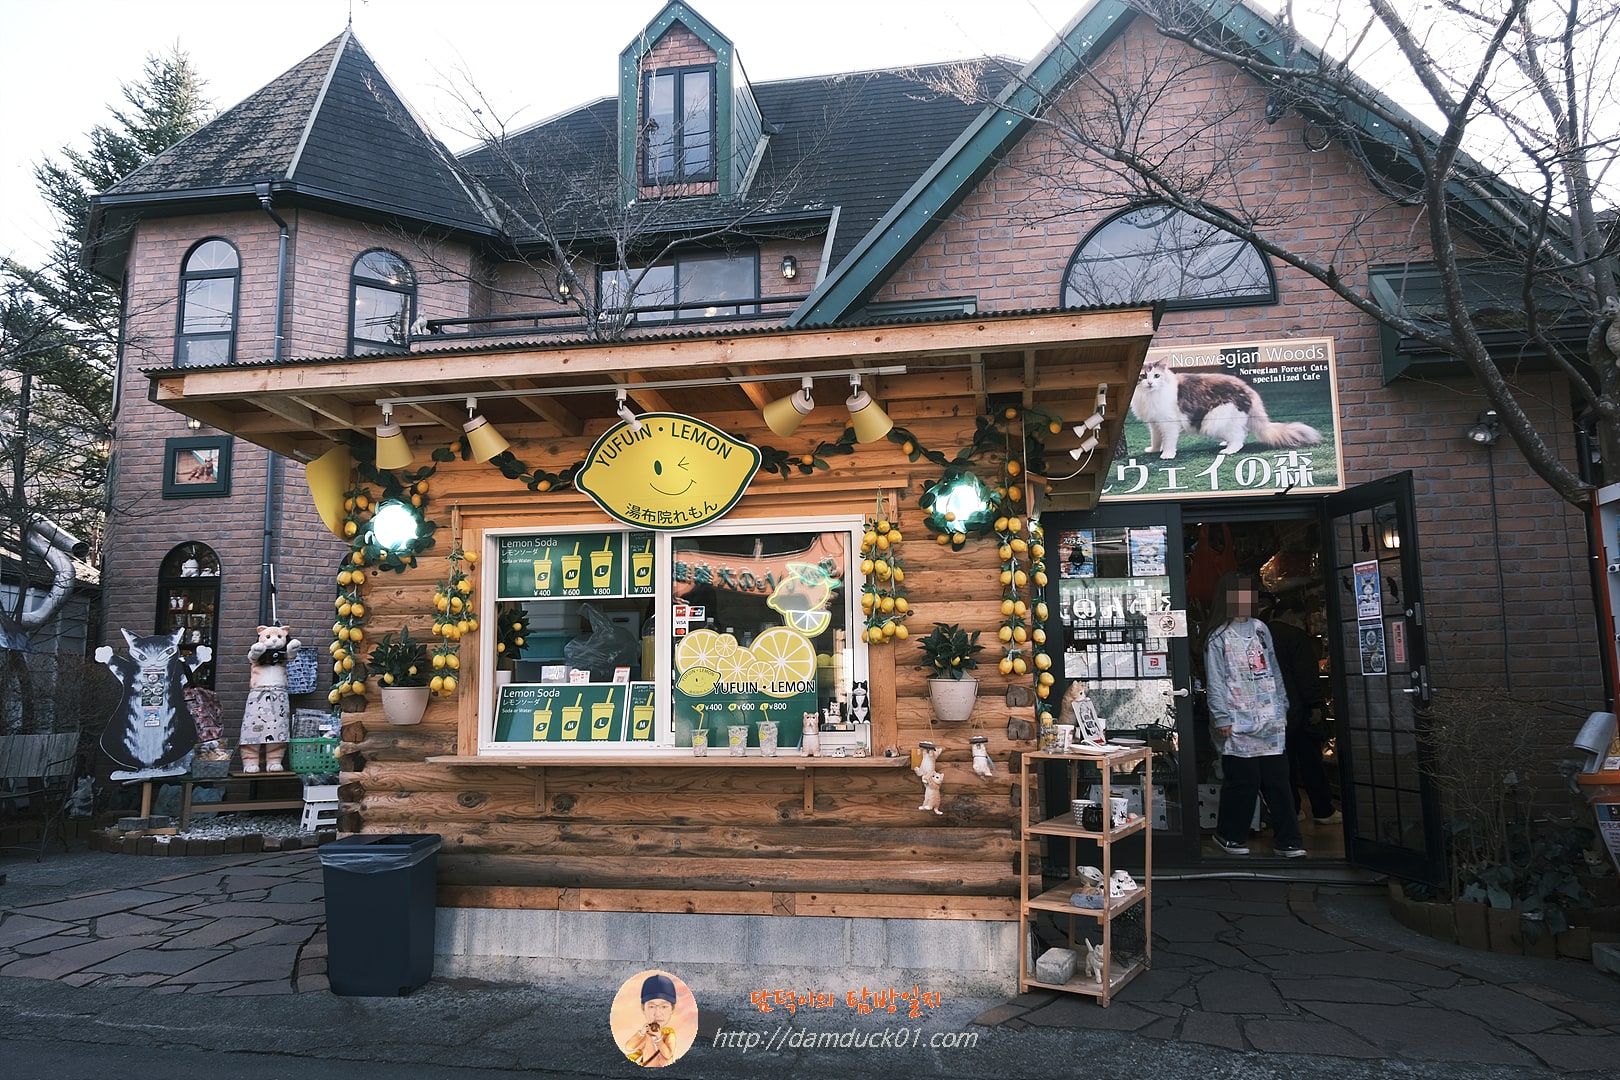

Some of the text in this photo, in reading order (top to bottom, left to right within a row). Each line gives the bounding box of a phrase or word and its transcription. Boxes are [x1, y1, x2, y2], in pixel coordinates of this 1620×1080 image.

[1172, 345, 1324, 368] Norwegian Woods
[1240, 367, 1278, 376] Norwegian
[1310, 364, 1328, 372] Cats
[1252, 374, 1300, 384] specialized
[595, 422, 732, 468] YUFUIN LEMON
[1101, 450, 1315, 494] ウェイの森
[625, 501, 718, 524] 湯布院れもん
[502, 538, 558, 548] Lemon Soda
[502, 548, 538, 556] レモンソーダ
[562, 588, 580, 596] ¥600
[634, 586, 652, 594] ¥700
[713, 682, 758, 693] YUFUIN
[771, 681, 815, 692] LEMON
[504, 688, 560, 698] Lemon Soda
[502, 698, 540, 706] レモンソーダ
